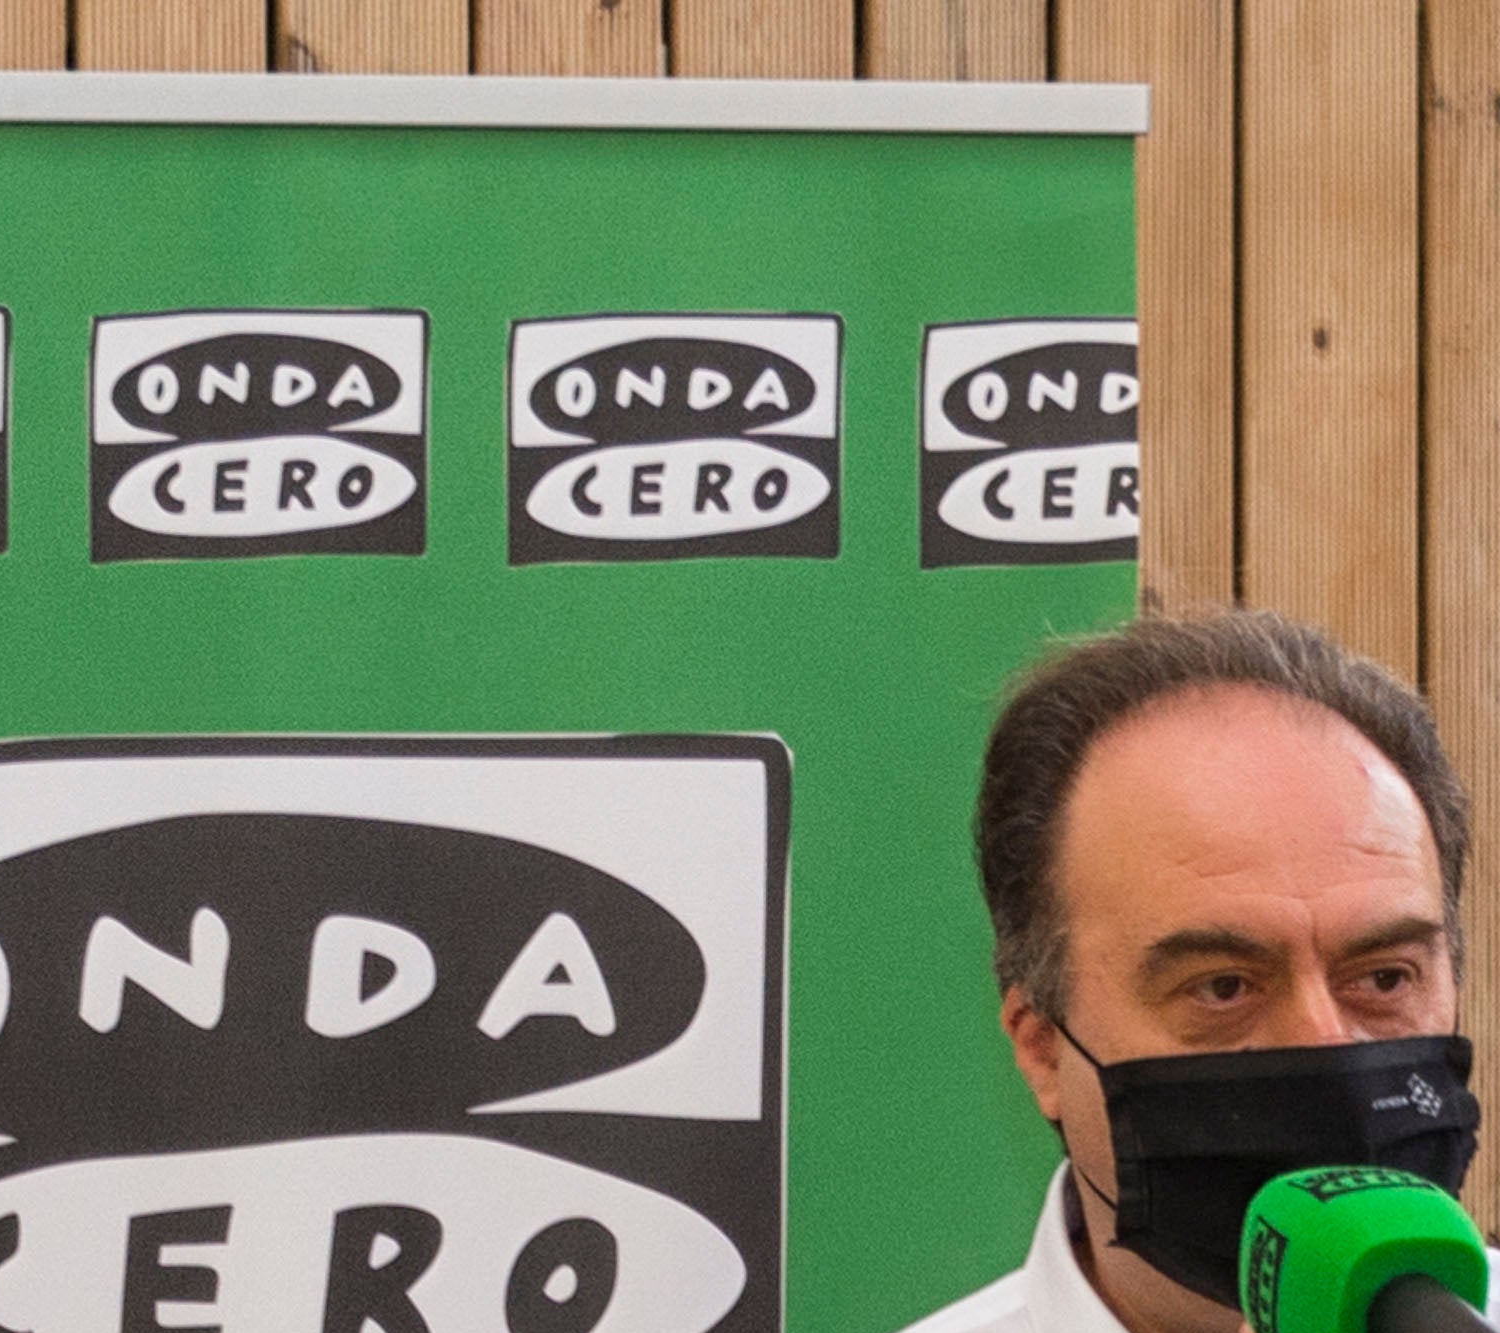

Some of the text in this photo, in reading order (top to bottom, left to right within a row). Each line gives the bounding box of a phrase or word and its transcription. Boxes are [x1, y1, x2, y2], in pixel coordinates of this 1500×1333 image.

[137, 362, 374, 414] ONDA
[555, 365, 790, 417] ONDA
[967, 369, 1140, 422] OND
[155, 461, 372, 512] CERO
[572, 464, 787, 515] CERO
[982, 466, 1139, 521] CER
